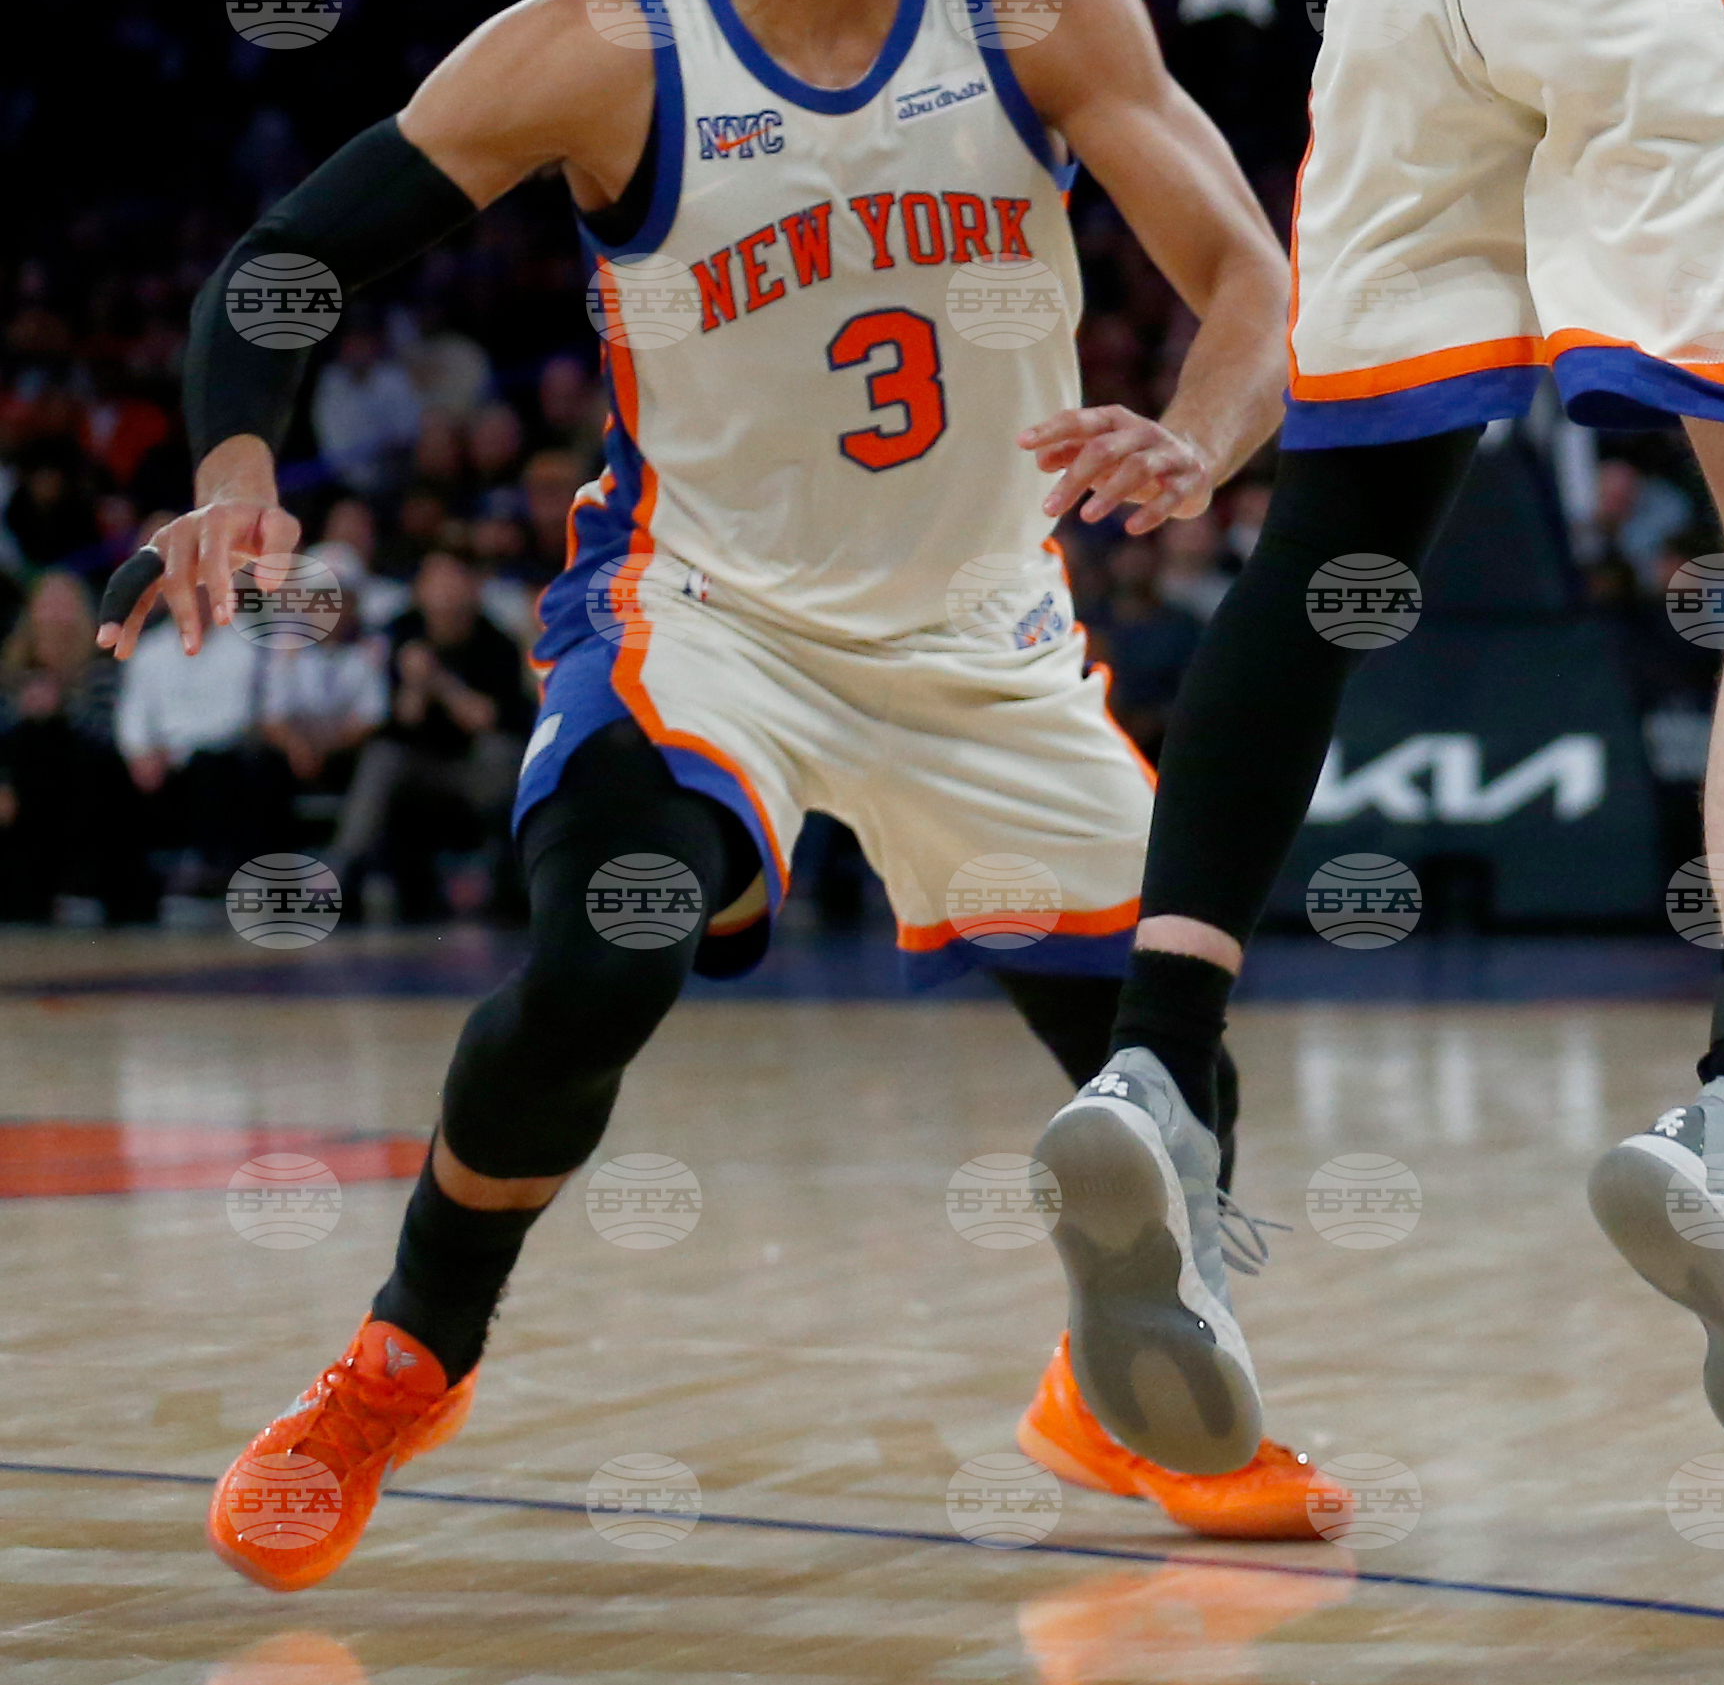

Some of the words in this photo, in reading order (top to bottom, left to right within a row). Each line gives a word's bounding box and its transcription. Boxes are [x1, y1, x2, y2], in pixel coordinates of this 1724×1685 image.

[697, 110, 784, 159] NYC
[690, 201, 832, 333] NEW
[850, 191, 1031, 270] YORK
[825, 307, 948, 473] 3
